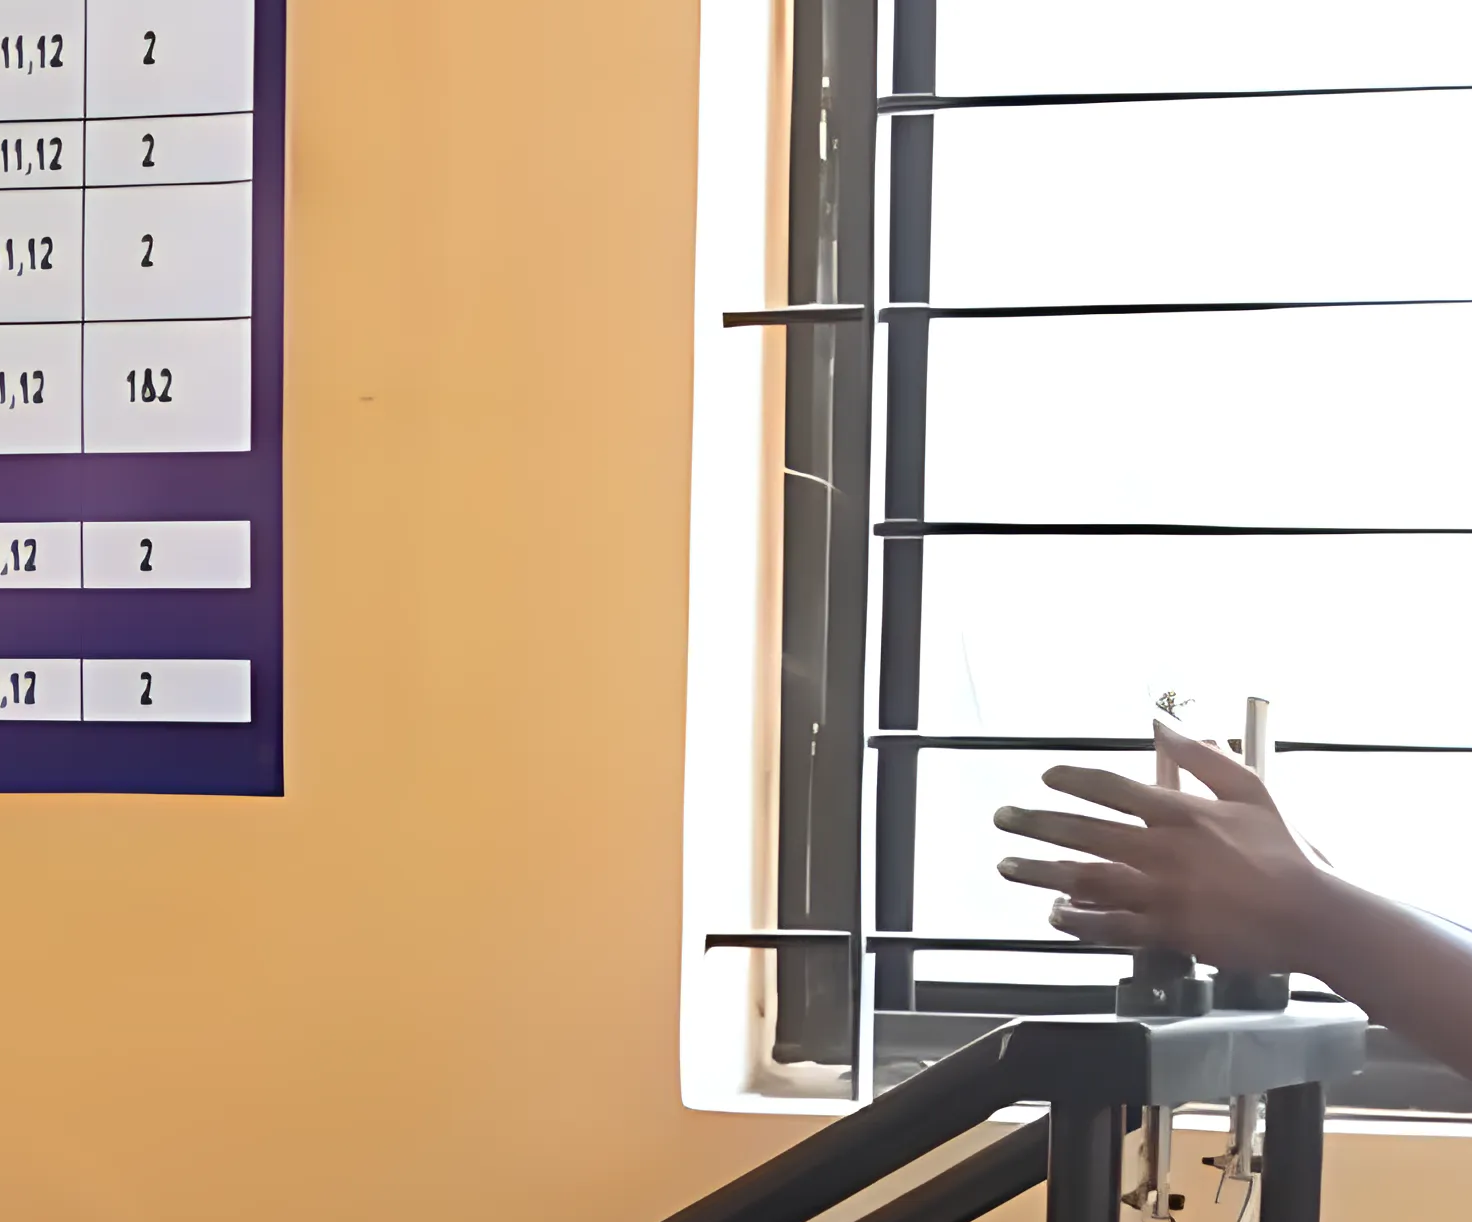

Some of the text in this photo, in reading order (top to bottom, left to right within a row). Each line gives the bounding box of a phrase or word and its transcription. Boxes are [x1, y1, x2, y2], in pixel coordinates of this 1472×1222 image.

[142, 30, 157, 65] 2
[141, 133, 155, 168] 2
[140, 233, 154, 268] 2
[139, 538, 153, 572] 2
[140, 670, 154, 706] 2
